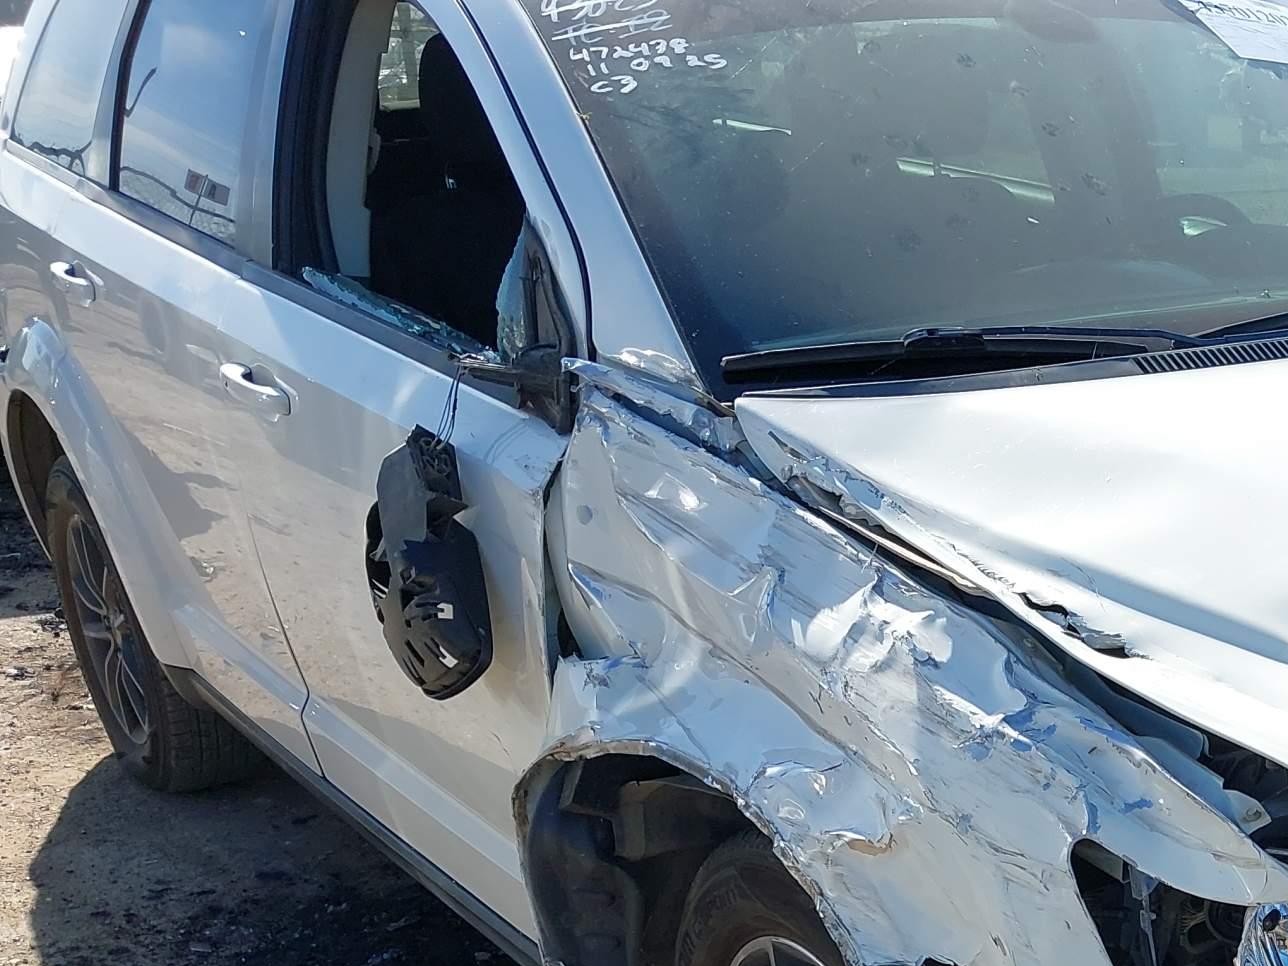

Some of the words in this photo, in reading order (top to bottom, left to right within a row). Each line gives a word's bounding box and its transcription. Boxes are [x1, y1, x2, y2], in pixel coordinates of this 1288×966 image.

[587, 62, 610, 76] 11
[686, 54, 728, 69] 25
[590, 75, 638, 93] C3
